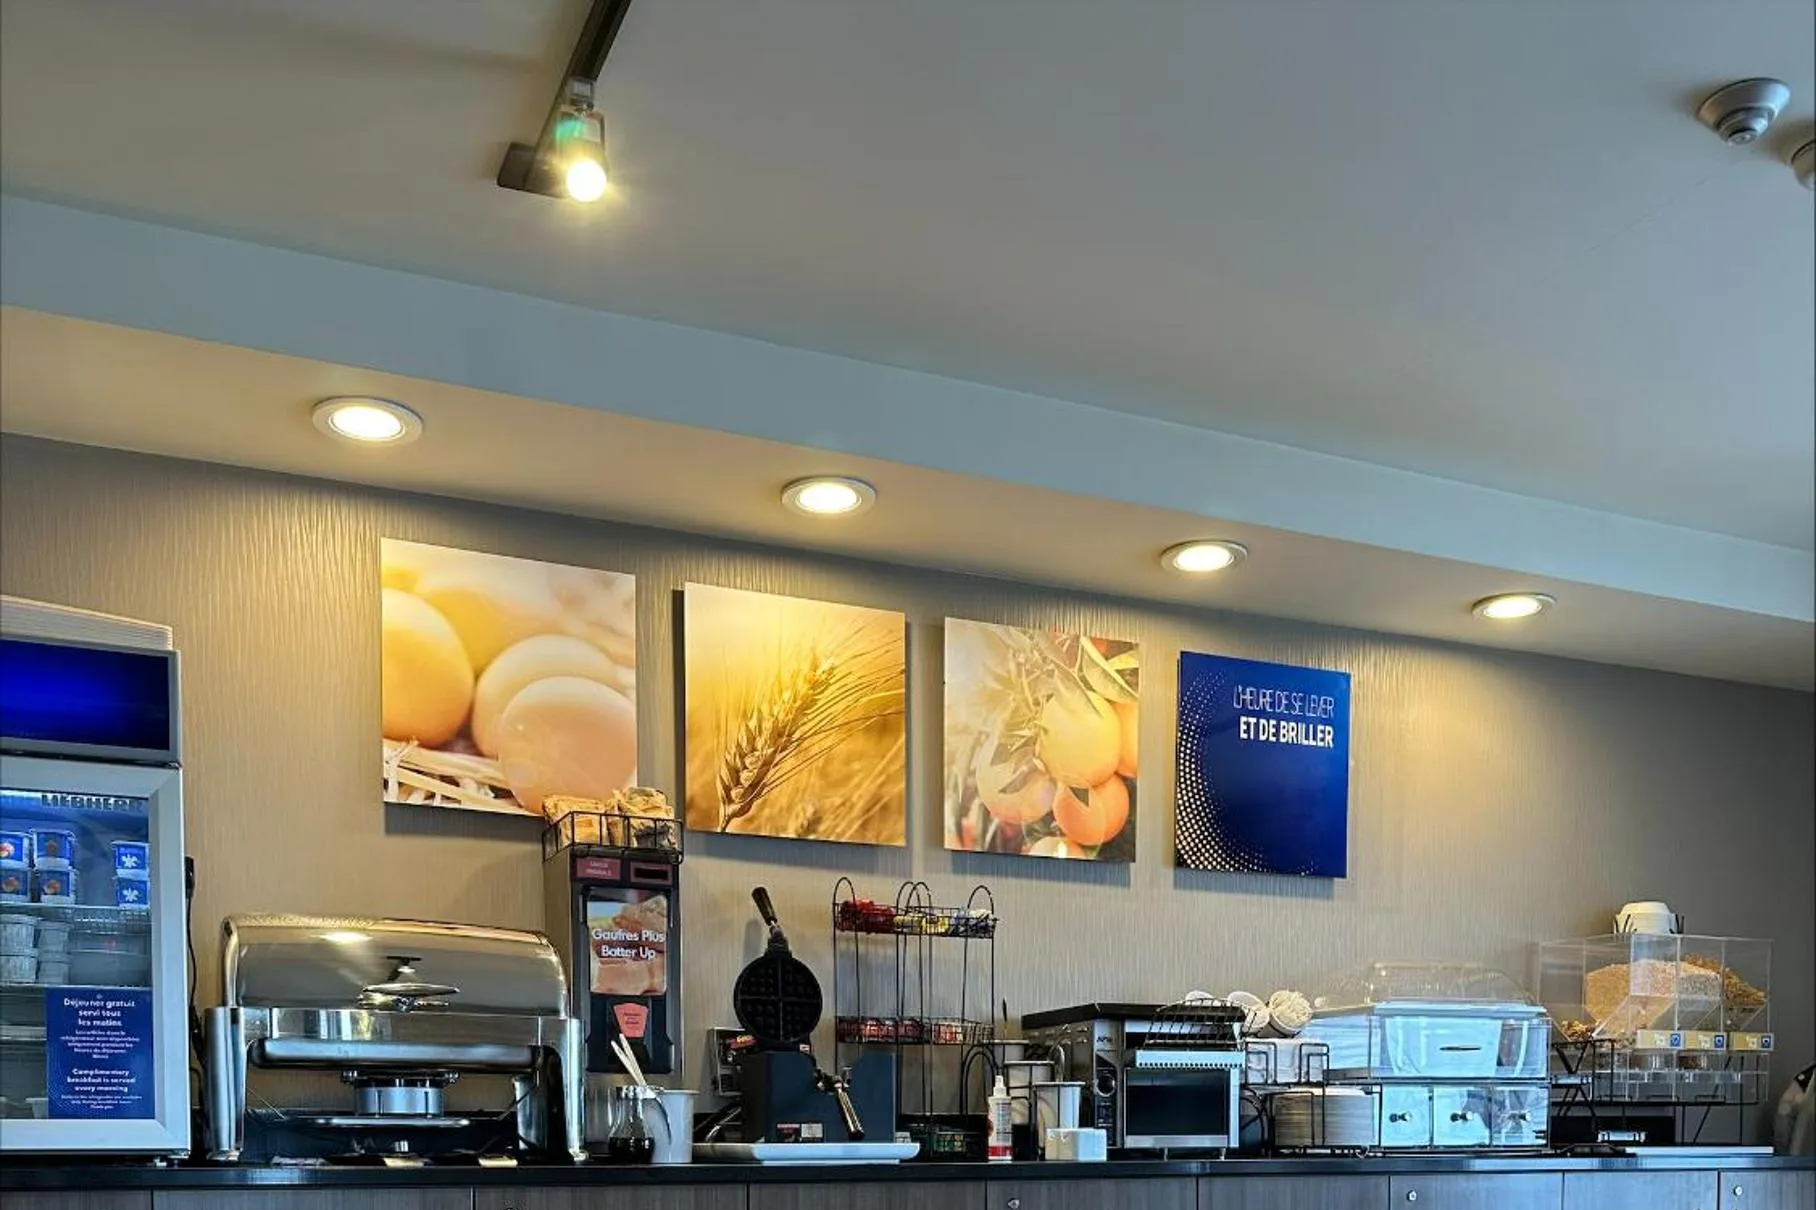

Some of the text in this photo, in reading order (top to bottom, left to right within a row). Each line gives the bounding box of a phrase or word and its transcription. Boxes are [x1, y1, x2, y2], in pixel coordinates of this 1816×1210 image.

[1275, 690, 1289, 714] DE
[1291, 692, 1304, 716] SE
[1305, 693, 1335, 719] LEVER
[1240, 715, 1334, 749] ET DE BRILLER
[592, 928, 666, 943] Gaufres Plus
[601, 944, 656, 961] Batter Up
[105, 999, 136, 1009] gratuit
[78, 1009, 121, 1017] servi tous
[78, 1018, 91, 1026] les
